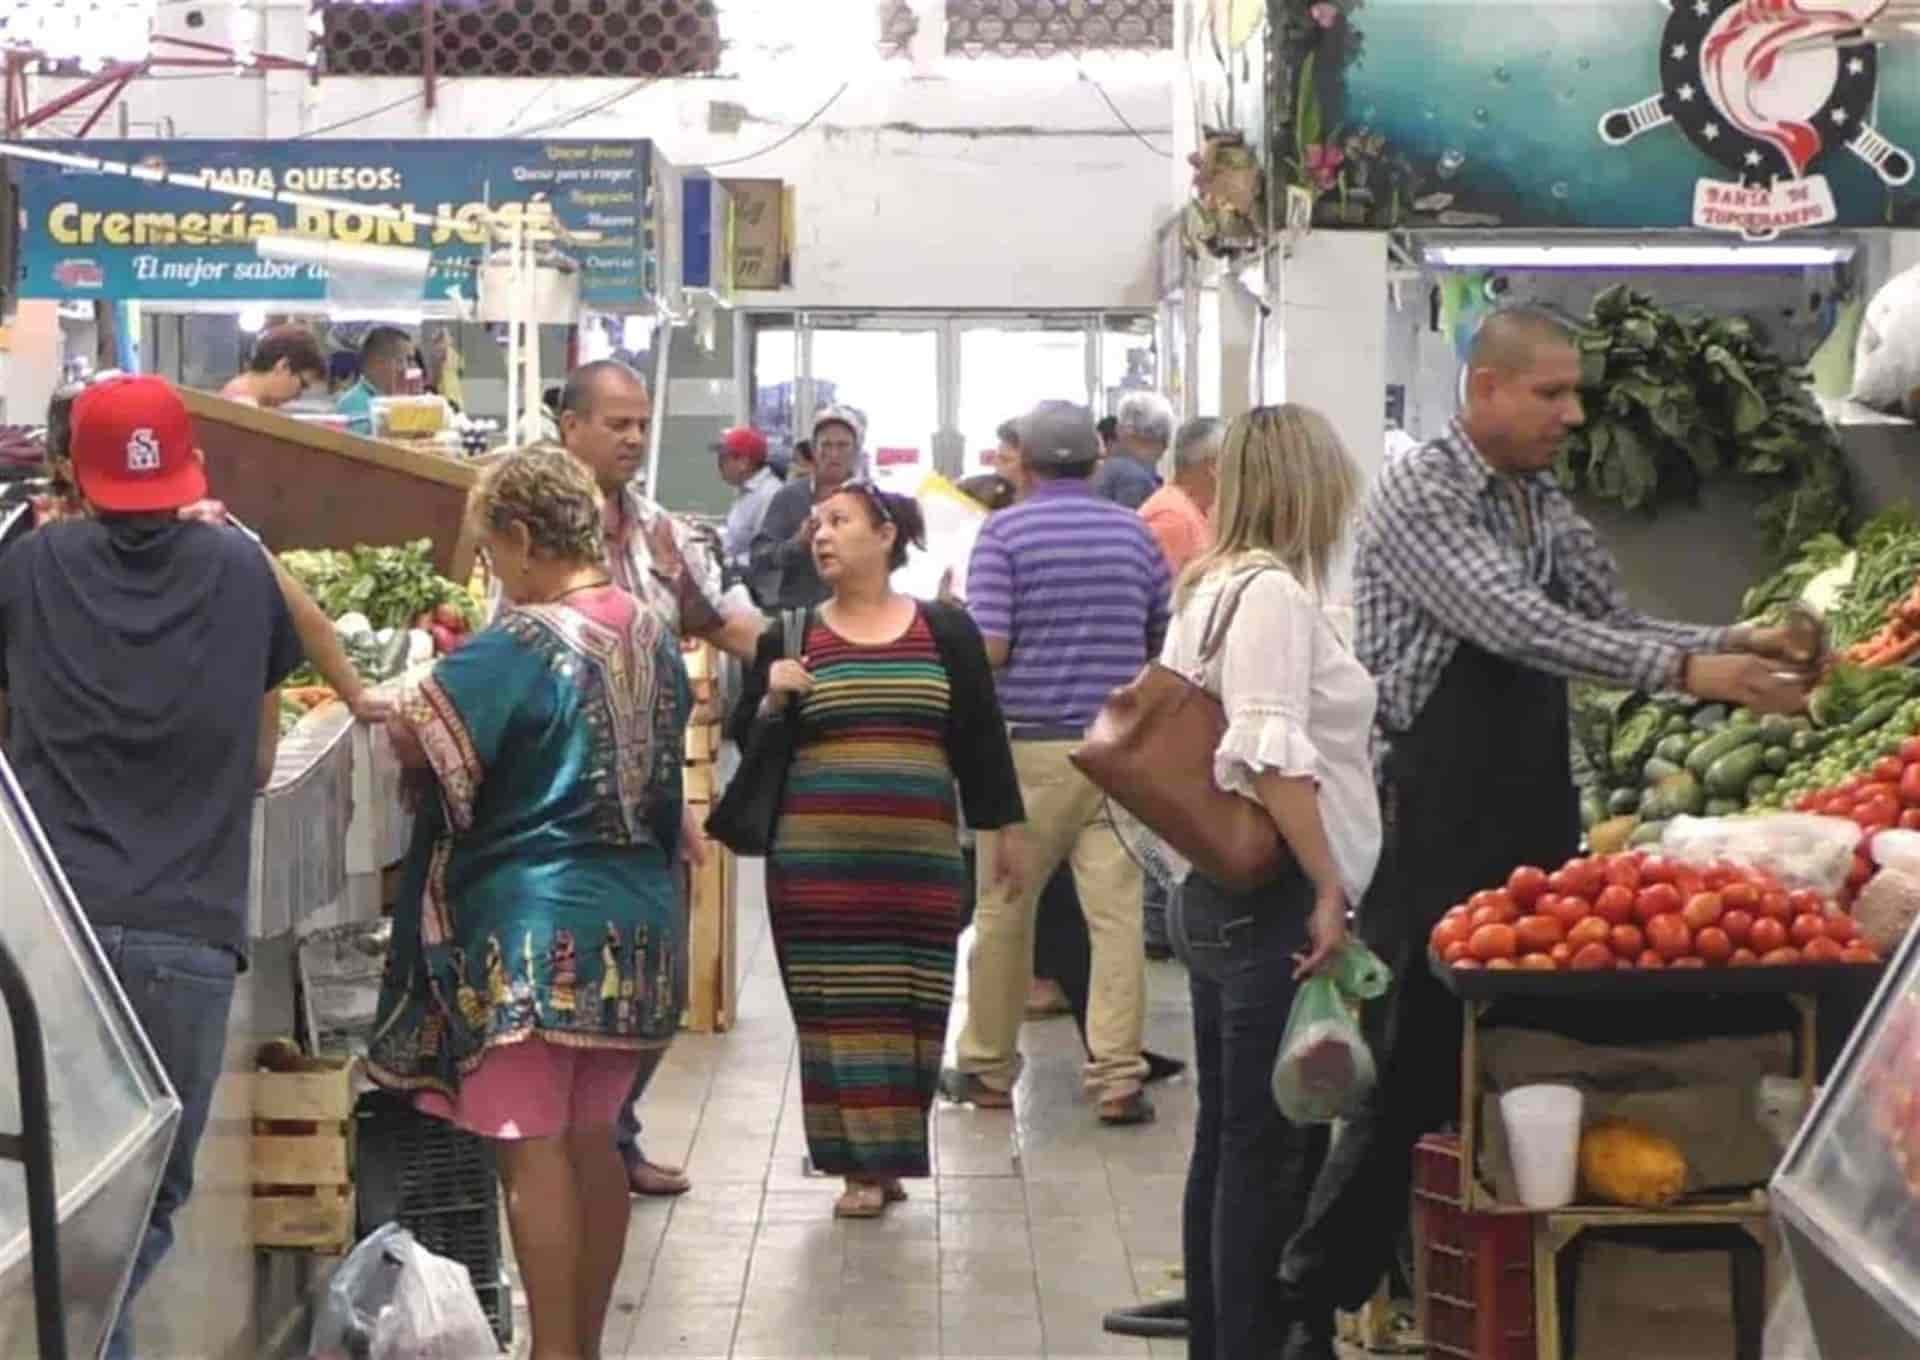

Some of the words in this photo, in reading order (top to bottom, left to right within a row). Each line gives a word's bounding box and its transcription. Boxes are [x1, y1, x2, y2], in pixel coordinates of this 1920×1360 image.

[200, 167, 275, 190] PARA
[284, 167, 402, 191] QUESOS:
[49, 201, 278, 245] Cremería
[297, 203, 416, 244] DON
[132, 255, 157, 279] El
[162, 257, 229, 287] mejor
[233, 256, 303, 281] sabor
